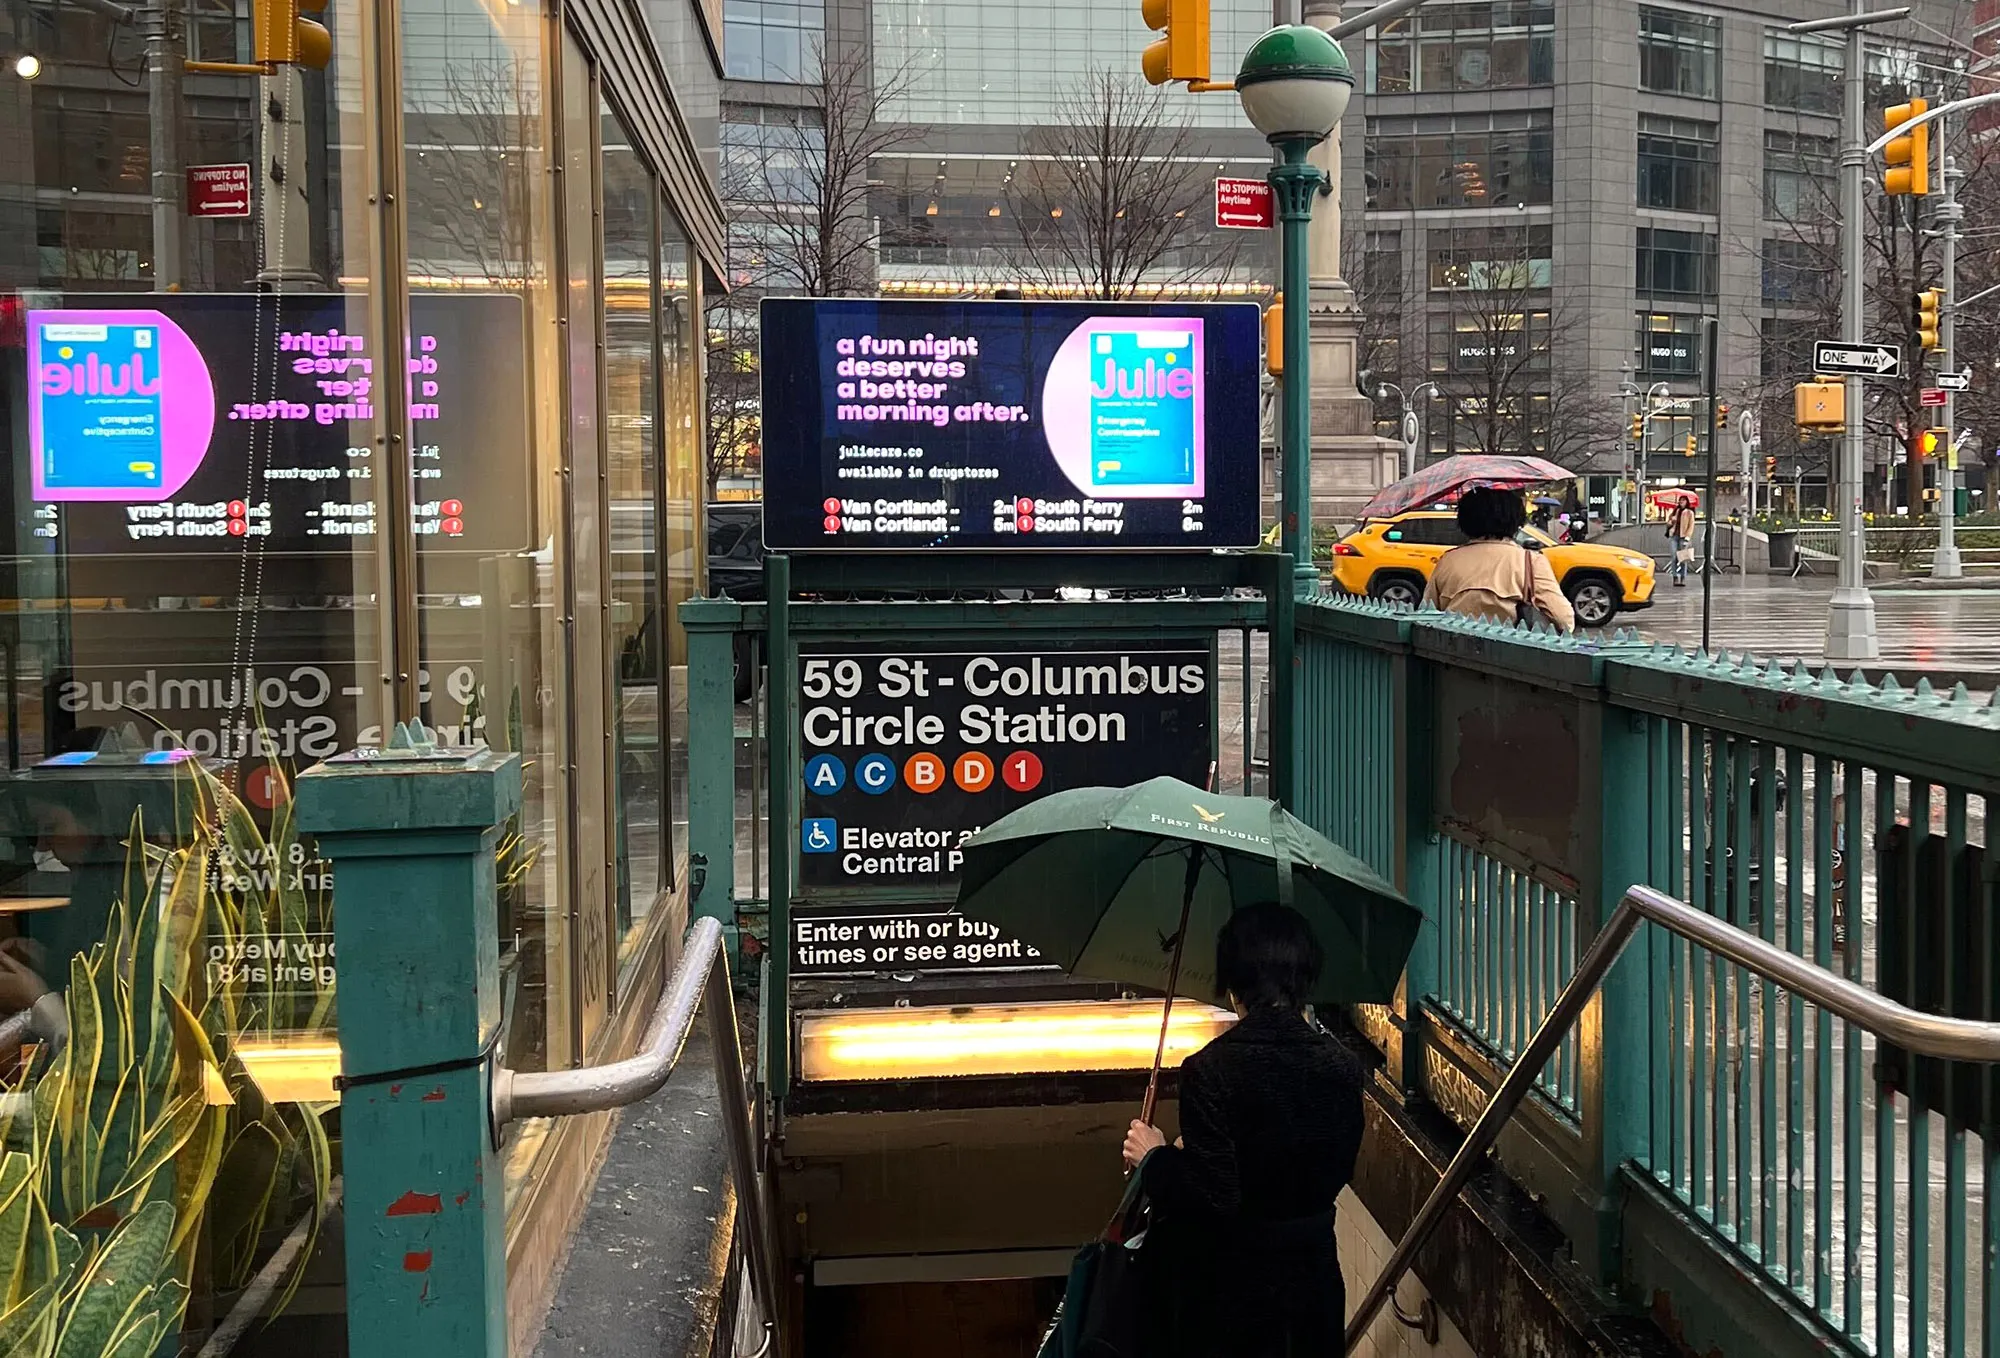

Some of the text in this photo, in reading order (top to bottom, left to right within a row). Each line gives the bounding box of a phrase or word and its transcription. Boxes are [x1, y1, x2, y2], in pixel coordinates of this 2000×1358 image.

[1220, 183, 1269, 195] NO STOPPING
[1221, 194, 1251, 206] Anytime
[837, 333, 978, 361] a fun night
[1651, 348, 1670, 357] HUGO
[837, 357, 966, 378] deserves
[1823, 352, 1887, 366] ONE WAY
[1091, 352, 1193, 399] Julie
[837, 379, 947, 399] a better
[837, 399, 1029, 427] morning after.
[838, 445, 924, 460] juliecare.co
[838, 466, 999, 481] available in drugstores
[841, 499, 871, 514] Van
[874, 499, 947, 515] Cortlandt
[993, 500, 1014, 514] 2m
[1034, 499, 1080, 515] South
[1083, 499, 1123, 517] Ferry
[1182, 500, 1203, 514] 2m
[841, 517, 871, 532] Van
[874, 516, 947, 532] Cortlandt
[1034, 517, 1080, 532] South
[1083, 517, 1123, 534] Ferry
[803, 660, 862, 698] 59
[878, 658, 929, 698] St
[964, 656, 1205, 697] Columbus
[803, 704, 1126, 747] Circle Station
[843, 828, 952, 849] Elevator
[1151, 813, 1270, 845] FIRST REPUBLIC
[843, 851, 940, 875] Central
[797, 918, 1000, 942] Enter with or buy
[798, 946, 866, 965] times
[873, 946, 898, 962] or
[904, 945, 947, 961] see
[953, 939, 1021, 963] agent
